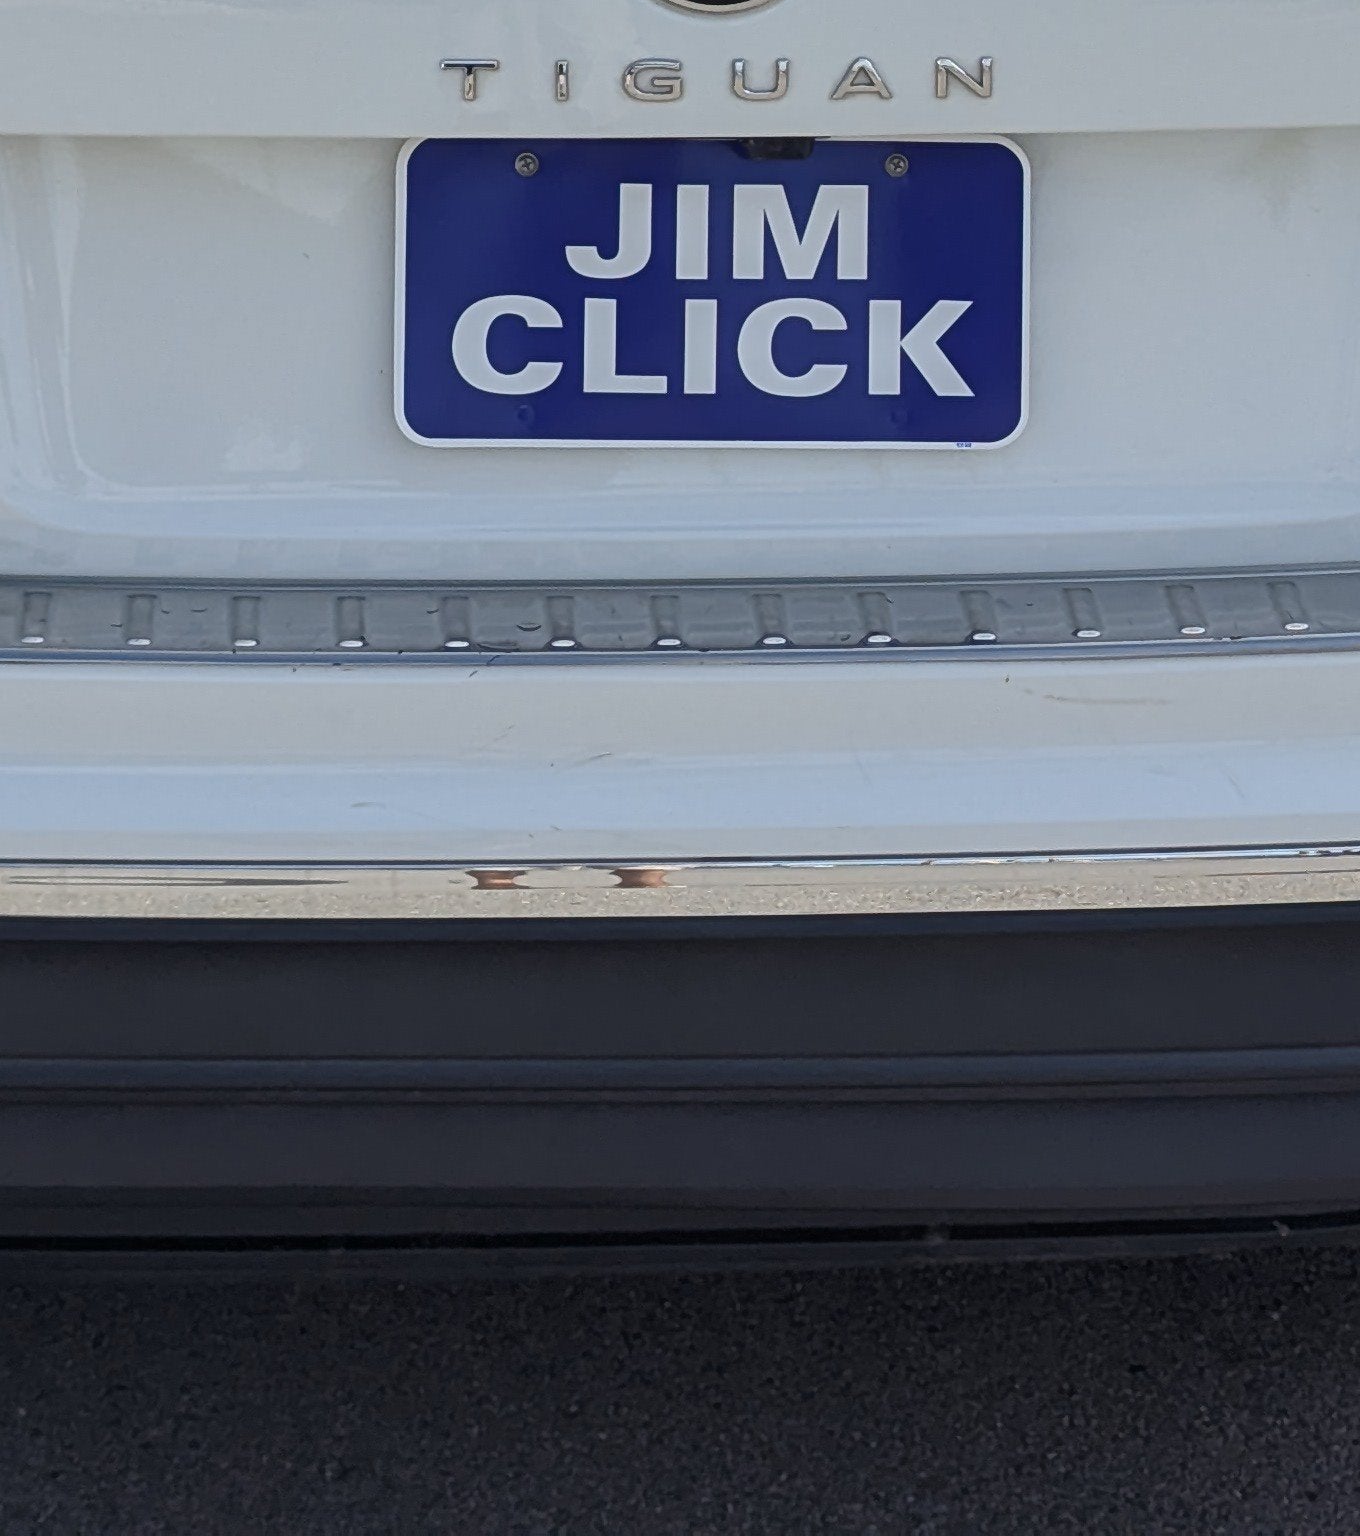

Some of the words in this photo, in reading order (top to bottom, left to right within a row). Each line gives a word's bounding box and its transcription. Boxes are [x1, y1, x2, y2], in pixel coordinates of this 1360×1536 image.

[440, 57, 994, 102] TIGUAN
[565, 182, 869, 280] JIM
[451, 294, 975, 397] CLICK
